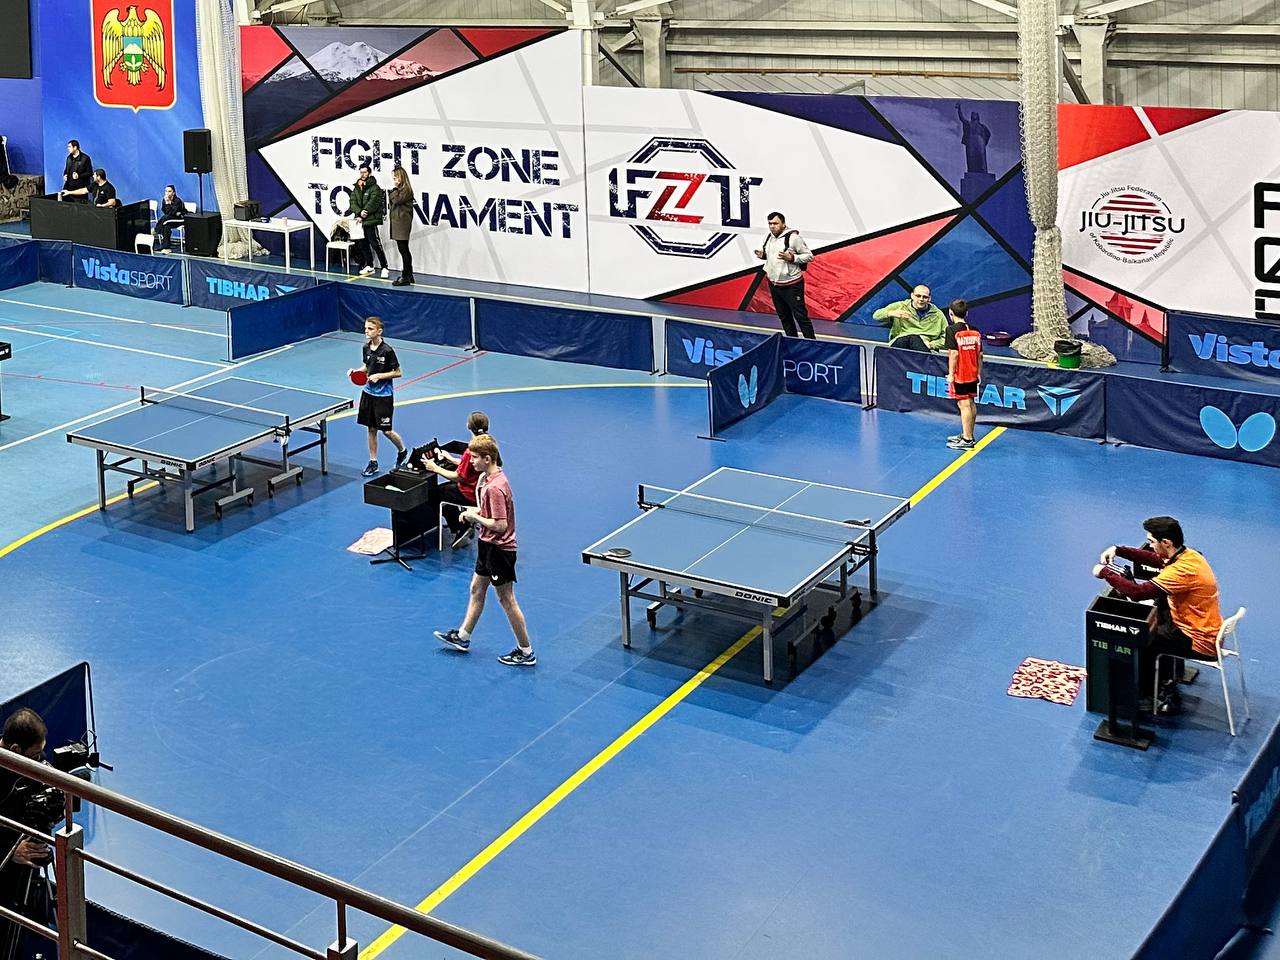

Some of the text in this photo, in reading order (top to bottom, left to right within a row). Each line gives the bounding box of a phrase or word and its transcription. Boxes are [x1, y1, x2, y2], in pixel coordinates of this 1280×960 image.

[311, 136, 560, 186] FIGHT ZONE
[1127, 185, 1162, 202] Federation
[308, 183, 579, 239] TONAMENT
[1079, 211, 1185, 235] JIU-JITSU
[81, 257, 173, 291] VistaSPORT
[206, 276, 270, 302] TIBHAR
[906, 371, 1027, 411] TIBAR
[735, 591, 773, 604] DONIC
[1095, 620, 1127, 634] TIBHAR
